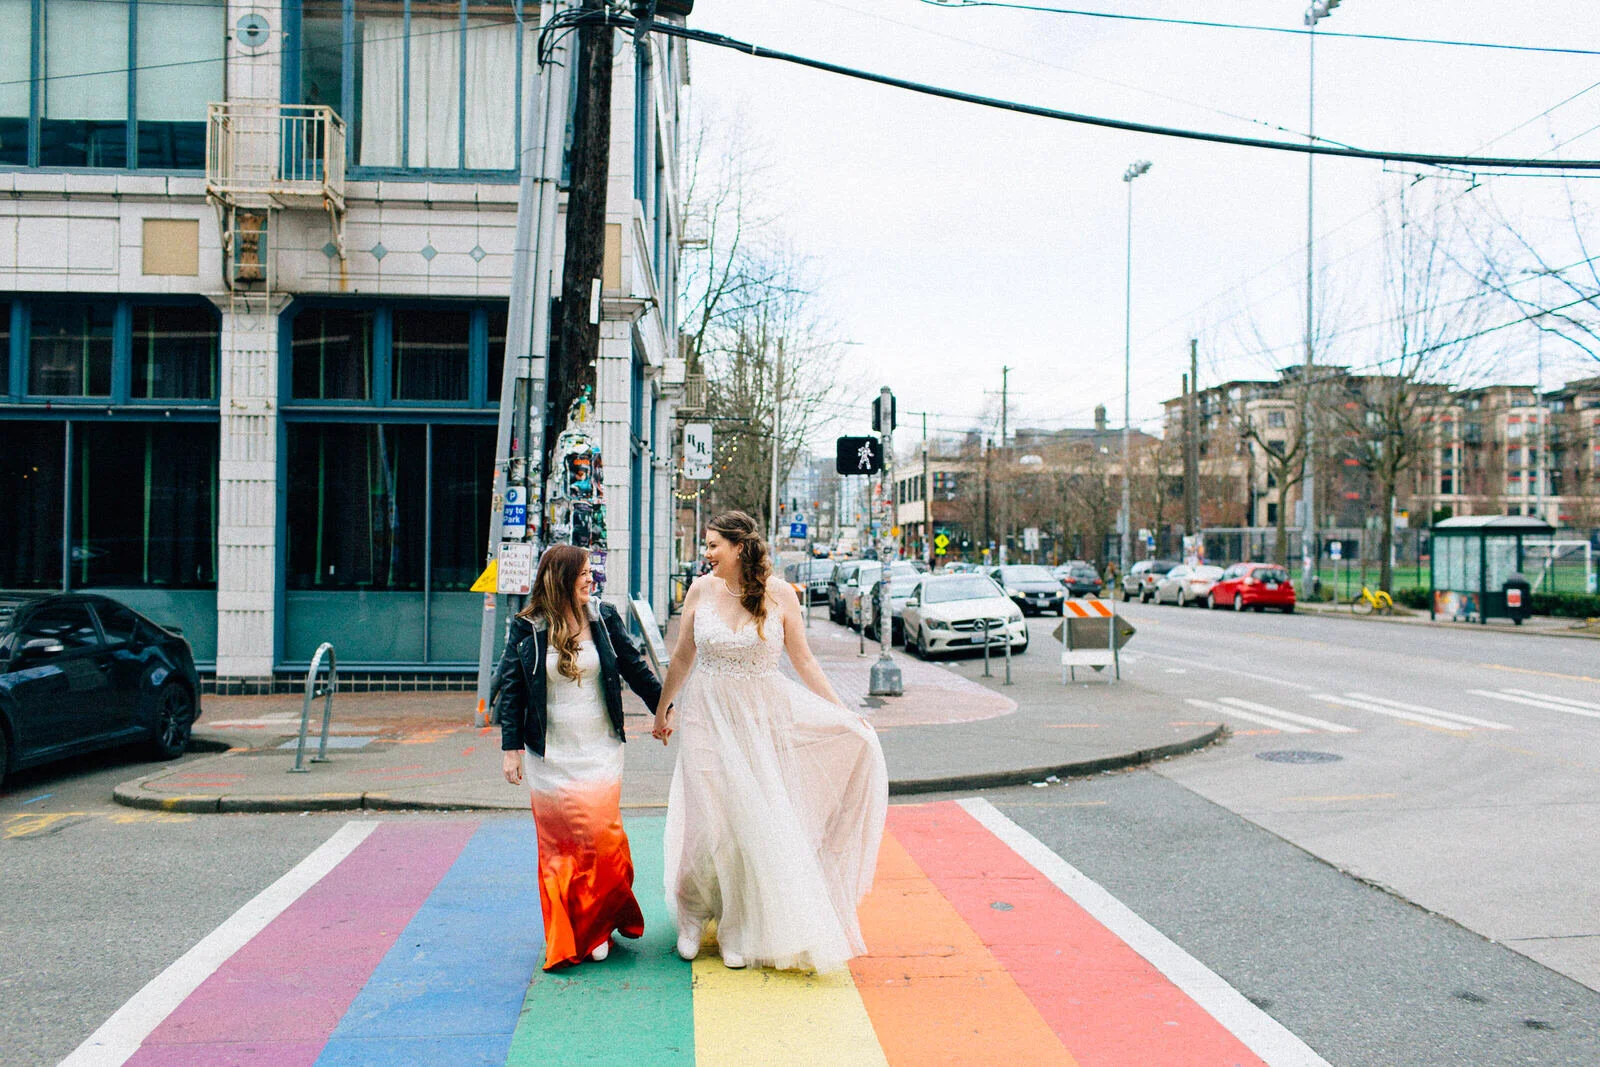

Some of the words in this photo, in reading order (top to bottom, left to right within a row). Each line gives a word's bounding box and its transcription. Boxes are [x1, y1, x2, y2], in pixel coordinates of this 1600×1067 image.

[509, 491, 516, 500] P
[504, 507, 514, 516] ay
[515, 506, 524, 515] to
[795, 524, 802, 532] 2
[501, 569, 529, 577] PARKING
[505, 577, 522, 585] ONLY
